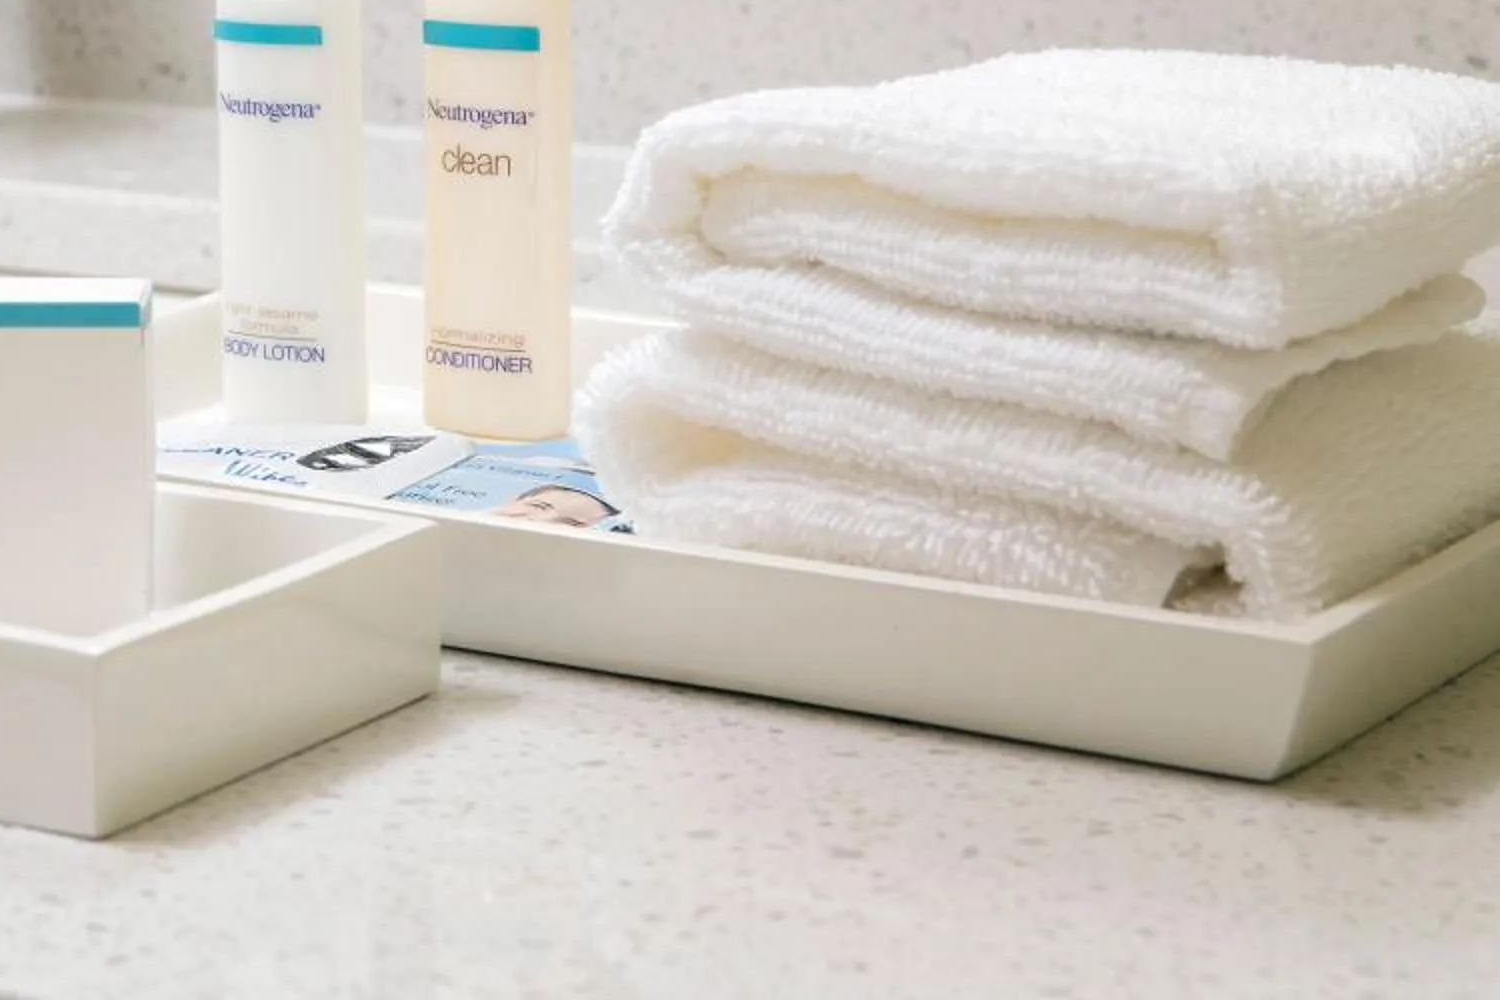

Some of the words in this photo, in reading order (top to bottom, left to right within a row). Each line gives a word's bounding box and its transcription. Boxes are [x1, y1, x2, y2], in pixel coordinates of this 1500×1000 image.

[441, 145, 512, 176] clean
[224, 338, 259, 358] BODY
[263, 344, 325, 364] LOTION
[426, 346, 533, 374] CONDITIONER
